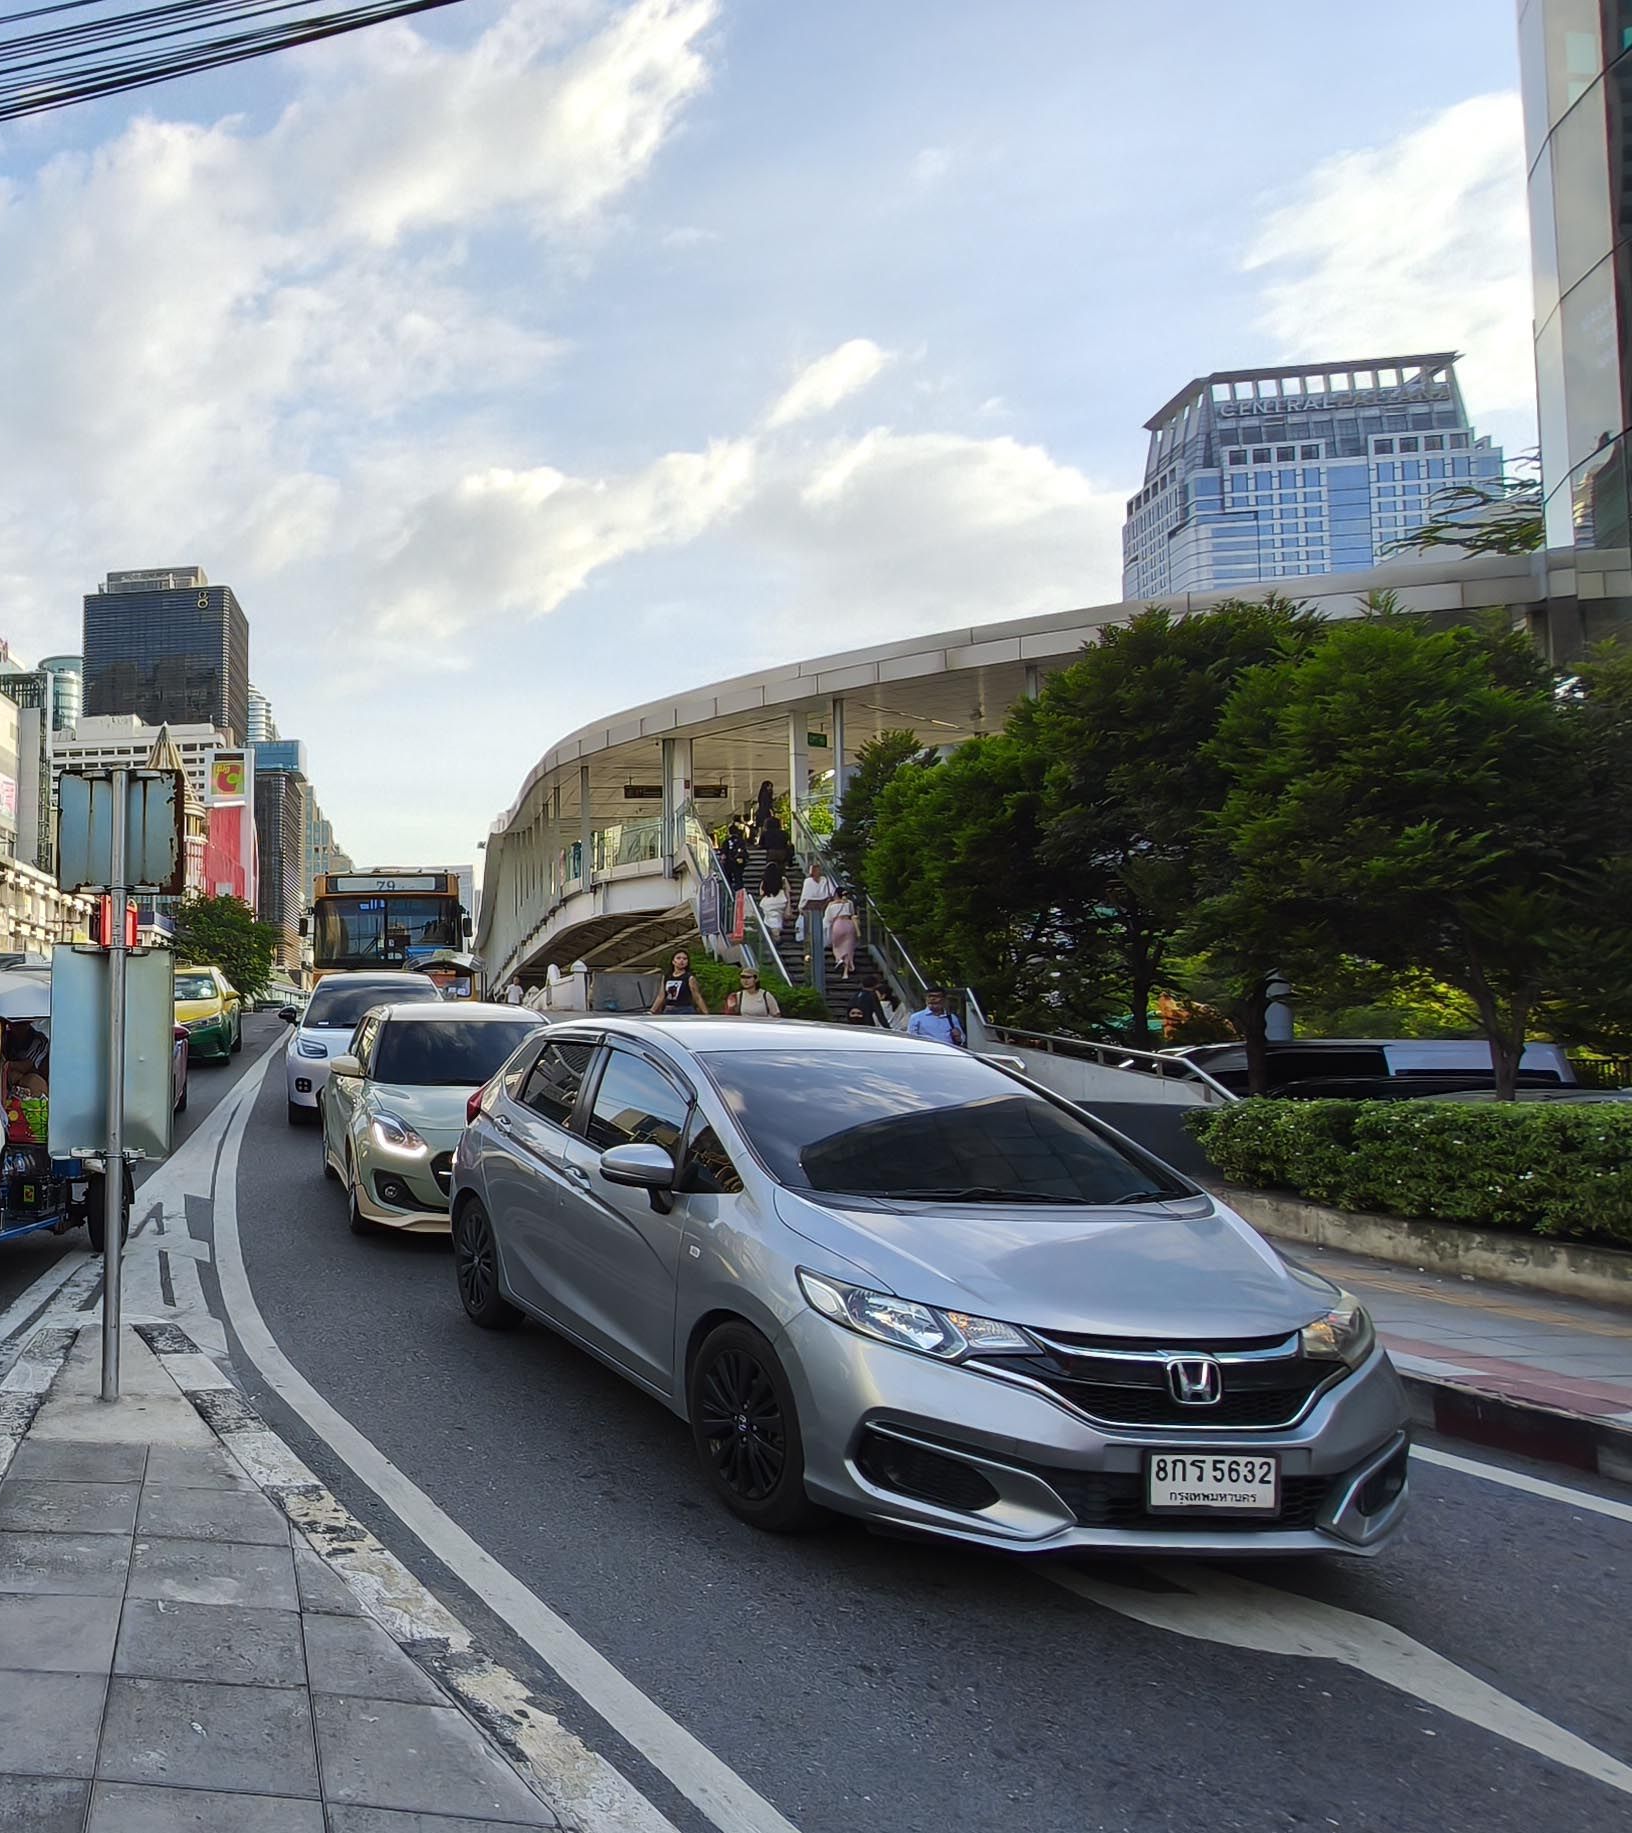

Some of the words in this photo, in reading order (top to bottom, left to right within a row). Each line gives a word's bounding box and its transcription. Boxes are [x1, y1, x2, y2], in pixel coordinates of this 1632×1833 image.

[1220, 397, 1336, 418] CENTRAL
[376, 880, 396, 890] 79
[1156, 1458, 1206, 1482] 8กร
[1212, 1460, 1272, 1485] 5632
[1169, 1491, 1257, 1505] กรุงเทพมหานคร
